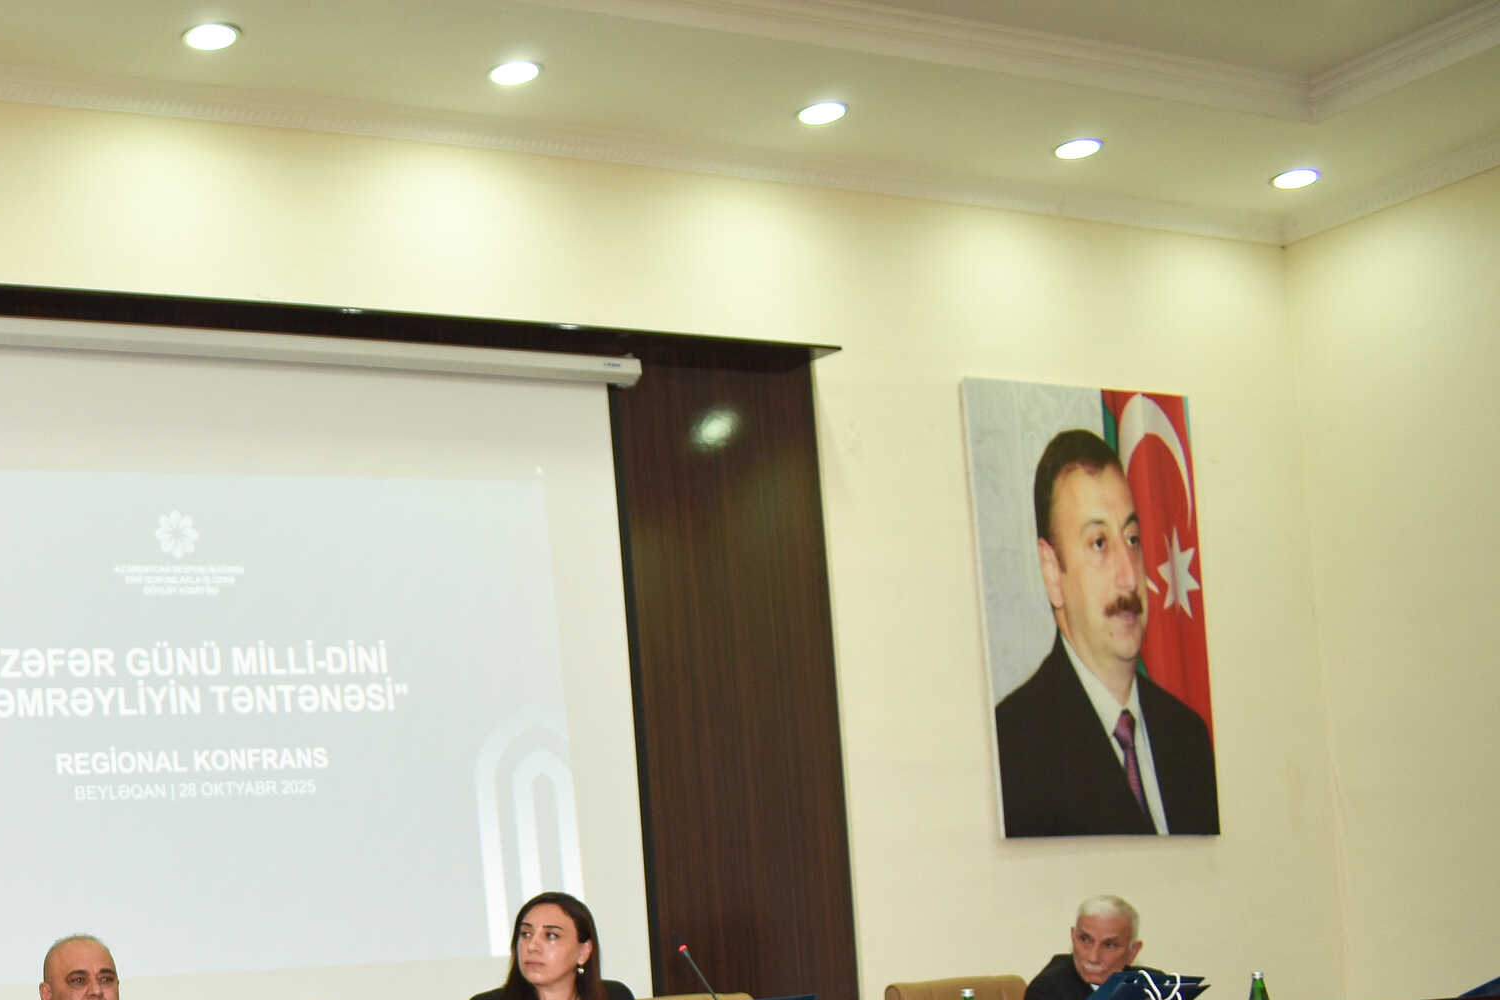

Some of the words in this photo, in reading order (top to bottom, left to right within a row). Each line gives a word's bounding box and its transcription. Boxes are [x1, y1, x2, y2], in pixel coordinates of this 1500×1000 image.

[126, 641, 221, 677] GÜNÜ
[232, 640, 388, 676] MİLLİ-DİNİ
[209, 677, 409, 714] TƏNTƏNƏSİ"
[56, 747, 188, 775] REGİONAL
[194, 747, 329, 772] KONFRANS
[75, 784, 166, 801] BEYLƏQAN
[179, 781, 196, 798] 28
[201, 780, 278, 797] OKTYABR
[281, 778, 317, 795] 2025
